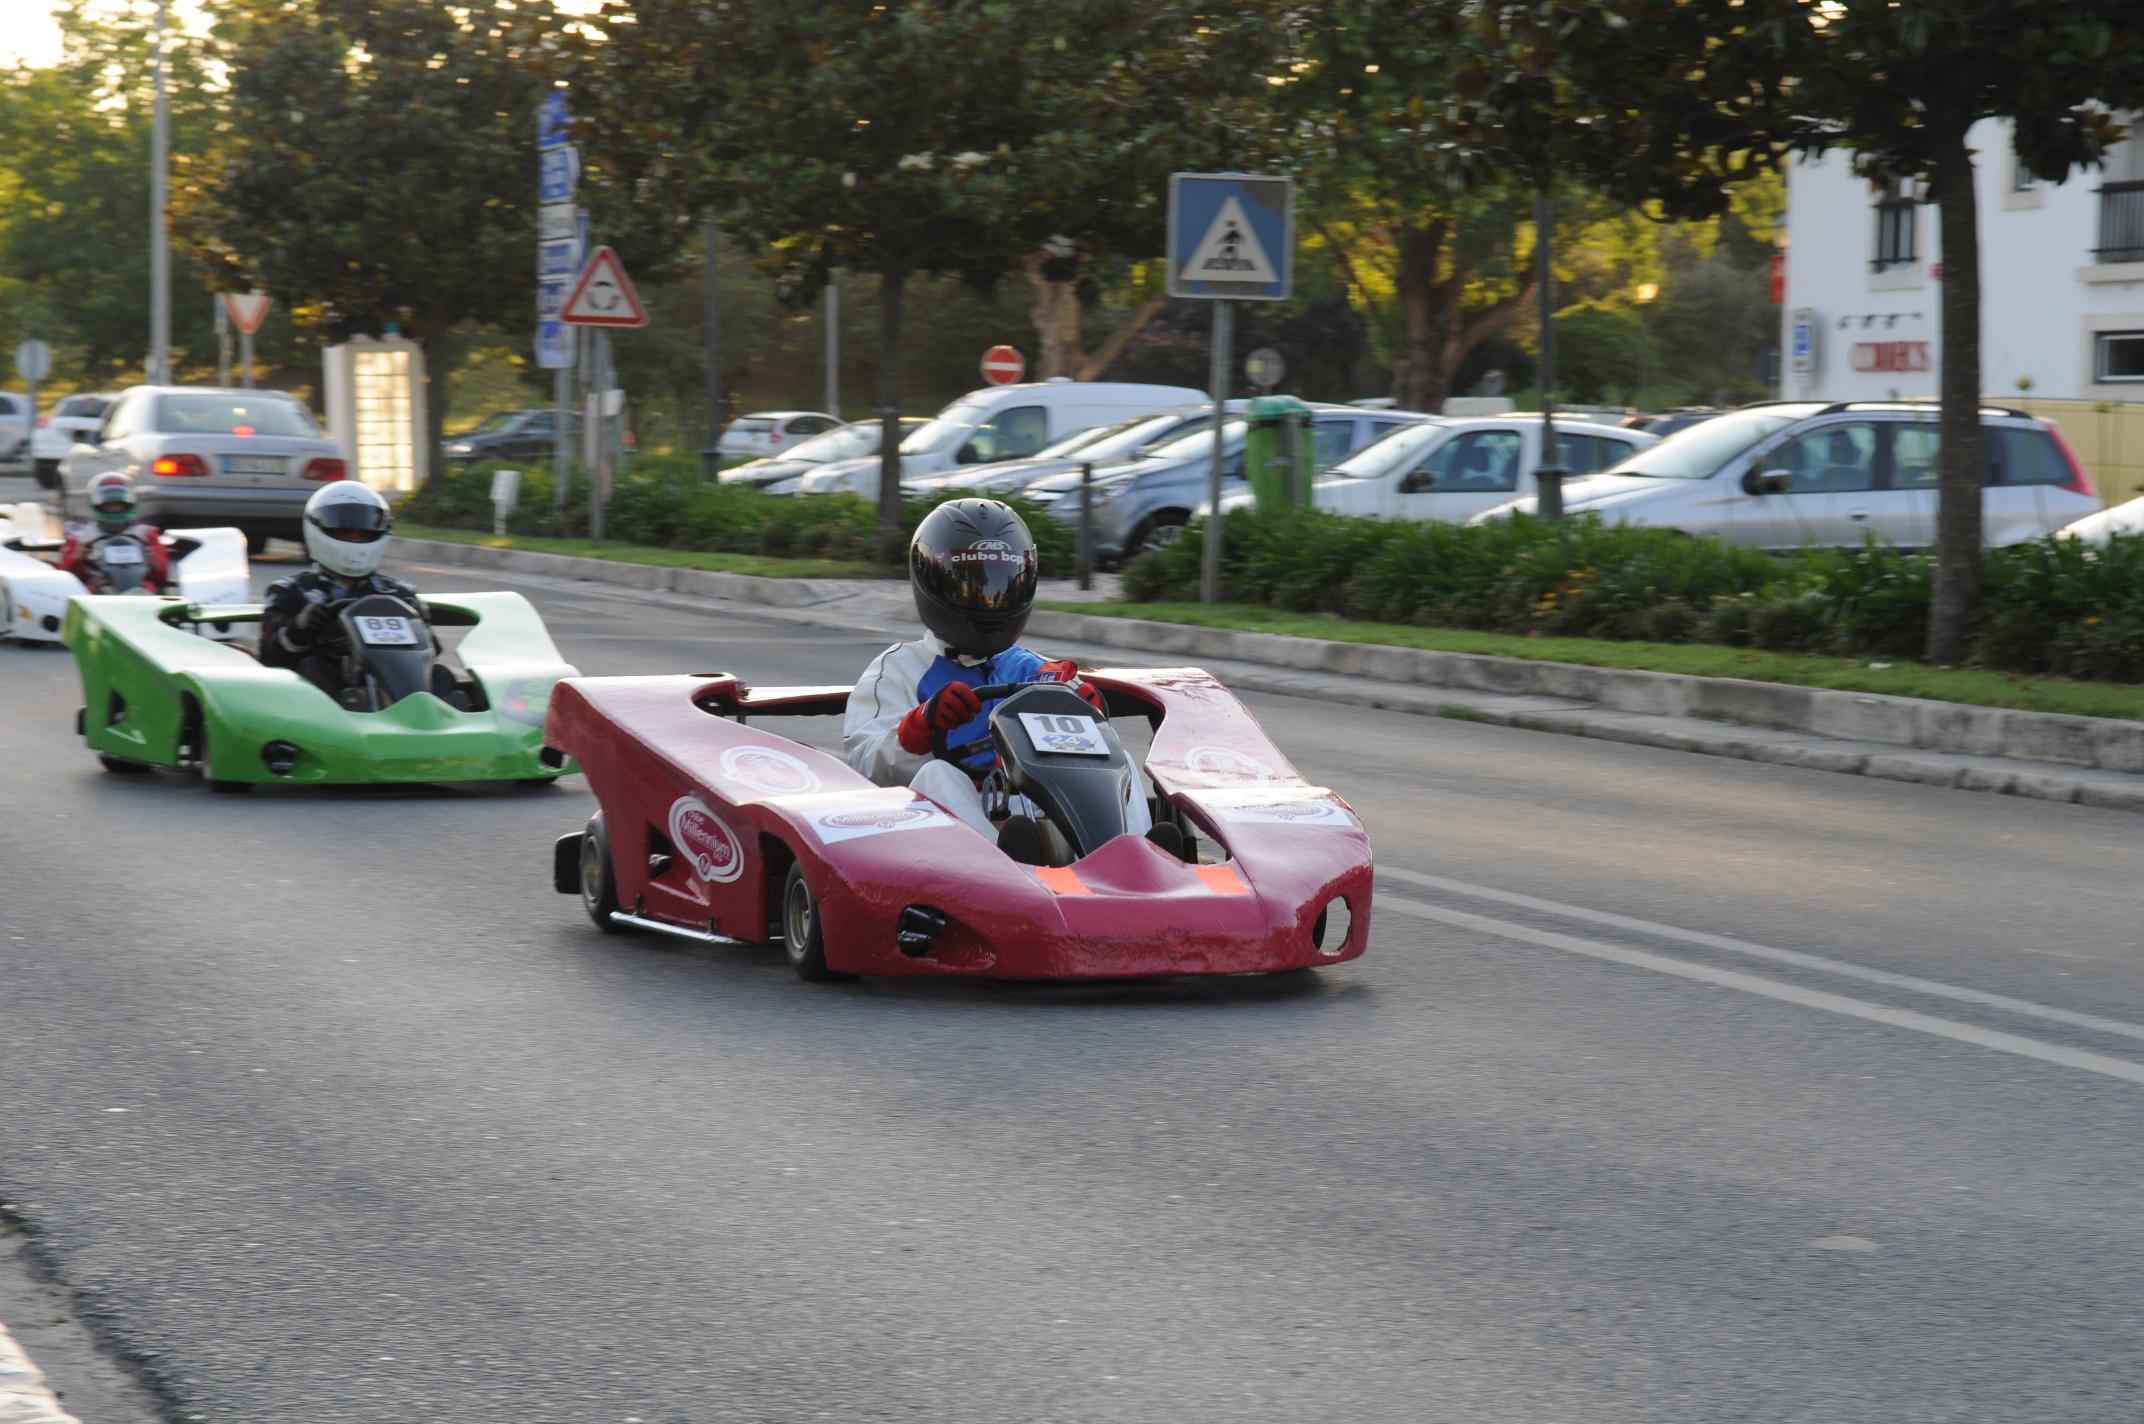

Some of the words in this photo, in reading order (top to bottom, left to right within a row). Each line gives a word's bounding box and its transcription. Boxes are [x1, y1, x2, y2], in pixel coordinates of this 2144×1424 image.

[976, 540, 1007, 551] CMS
[951, 551, 998, 562] clube
[1001, 550, 1025, 564] bcp
[366, 618, 402, 631] 89
[1033, 715, 1086, 734] 10
